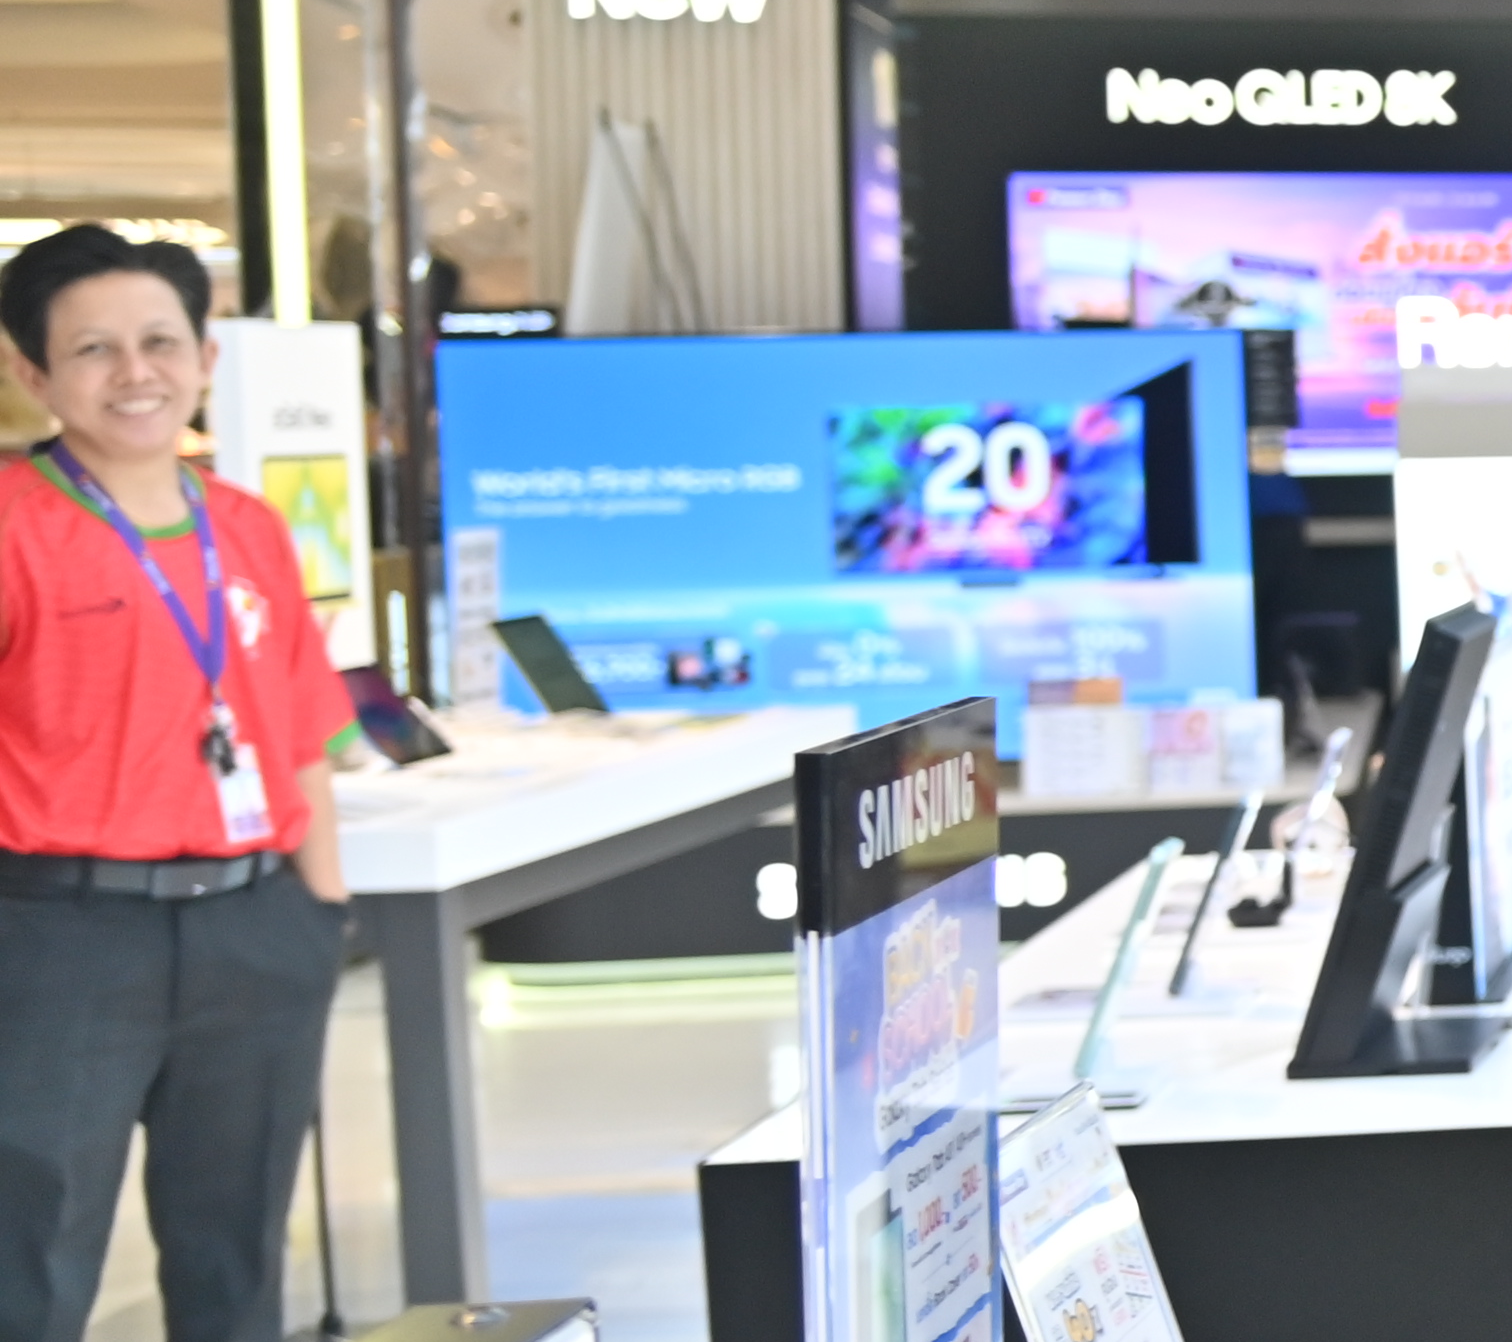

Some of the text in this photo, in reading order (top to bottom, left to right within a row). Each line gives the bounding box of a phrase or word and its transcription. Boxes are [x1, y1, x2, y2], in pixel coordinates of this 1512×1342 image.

[1105, 69, 1458, 126] Neo QLED 8K
[920, 421, 1052, 514] 20
[858, 750, 976, 870] SAMSUNG
